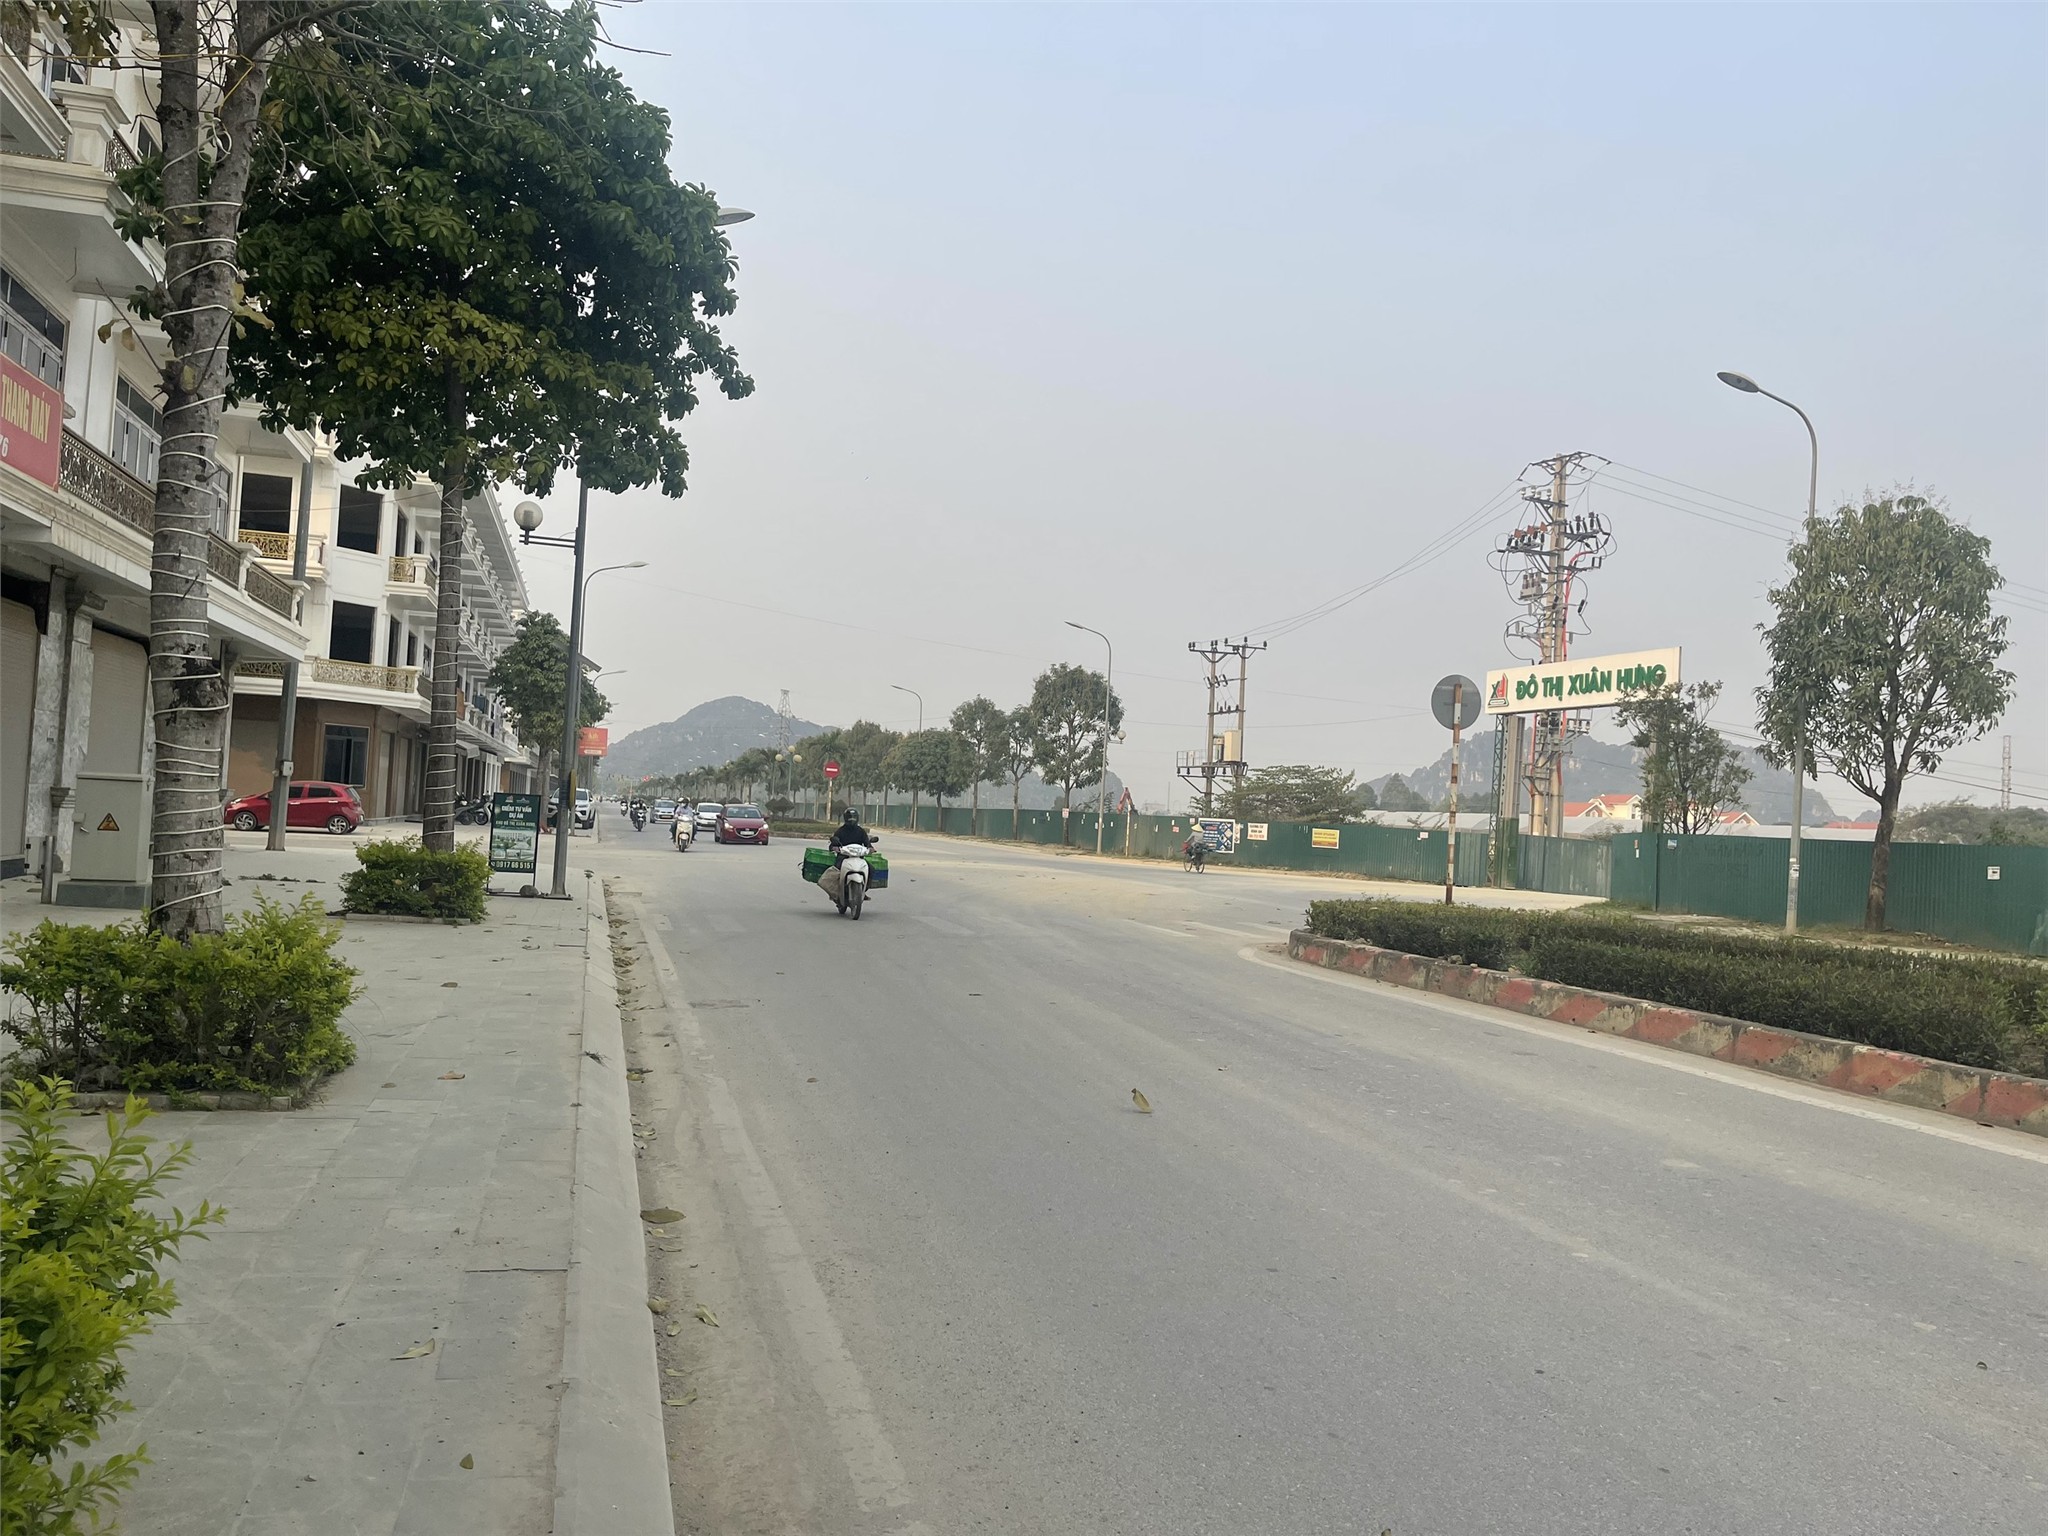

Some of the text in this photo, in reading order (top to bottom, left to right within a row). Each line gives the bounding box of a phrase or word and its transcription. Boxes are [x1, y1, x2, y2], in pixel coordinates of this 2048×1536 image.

[1, 374, 50, 444] THANG MÁY
[1516, 663, 1667, 701] ĐÔ THỊ XUÂN HƯNG
